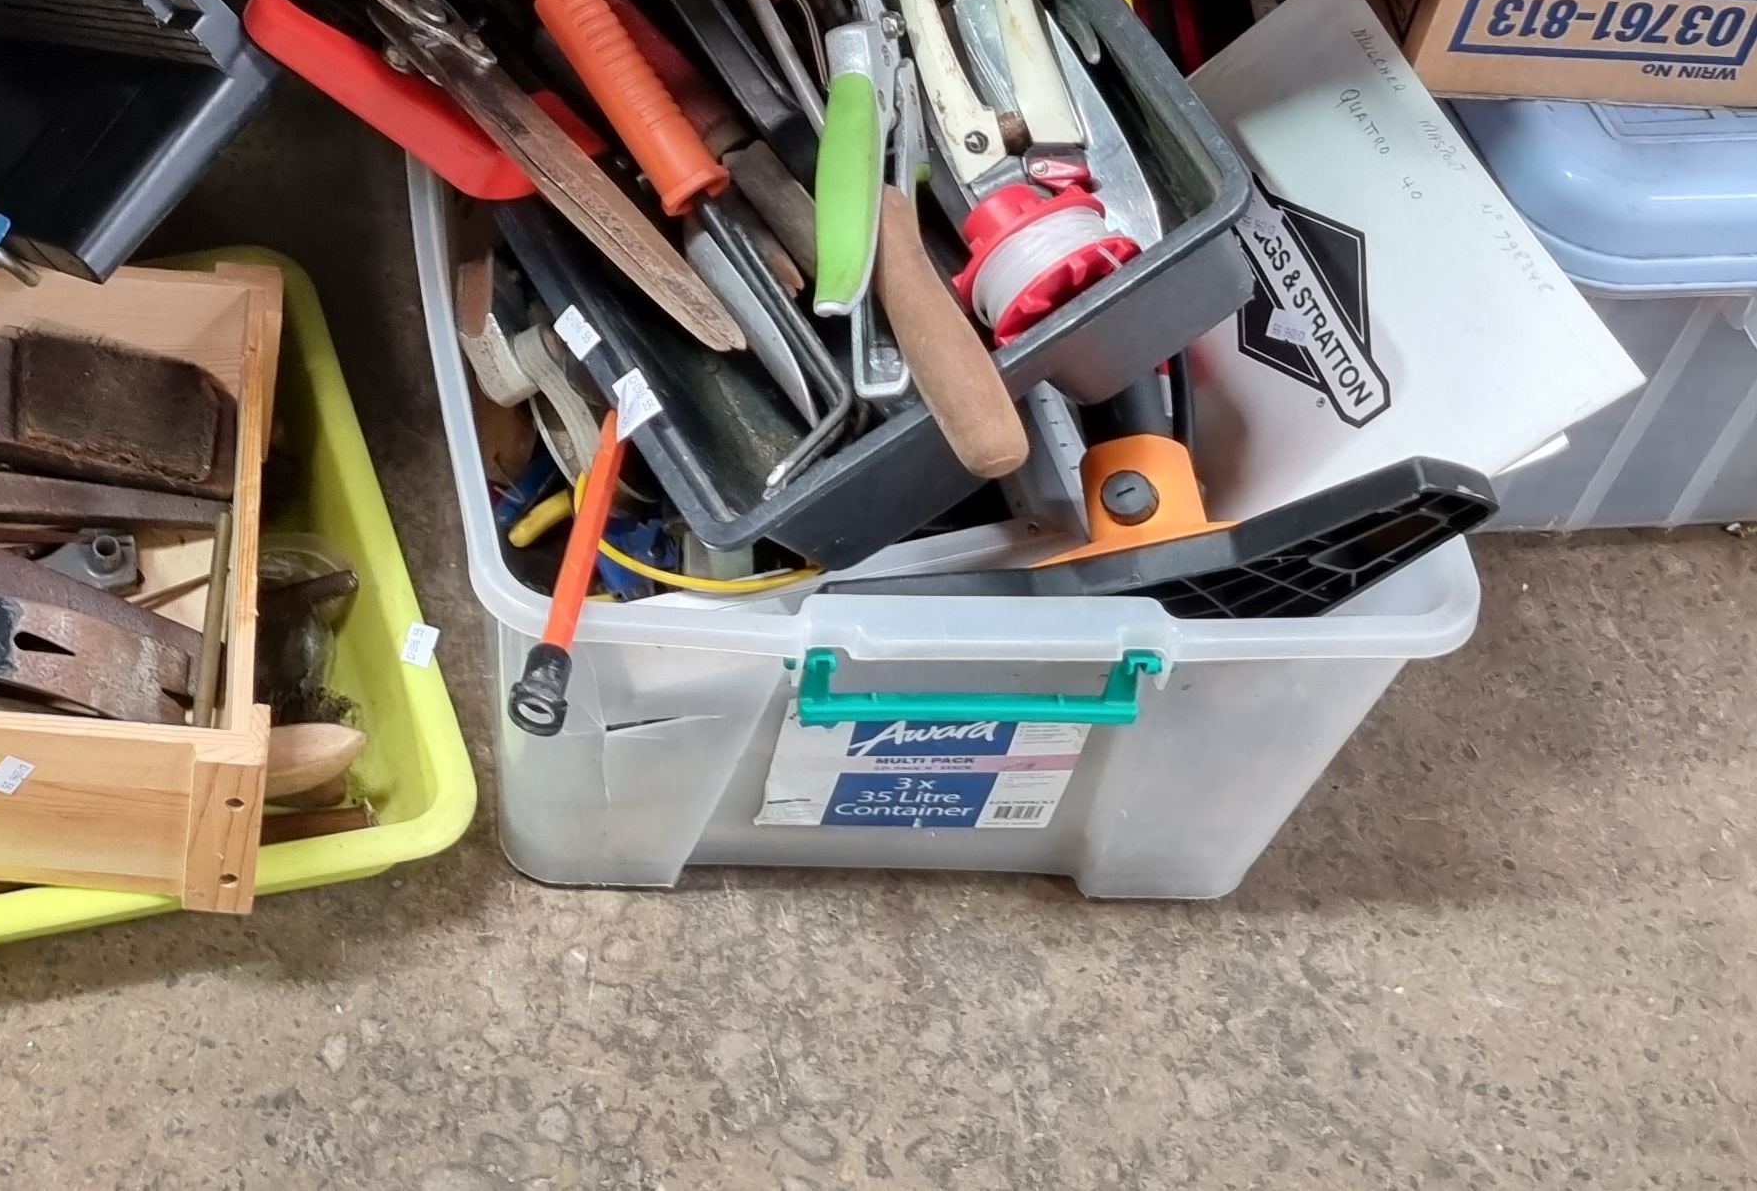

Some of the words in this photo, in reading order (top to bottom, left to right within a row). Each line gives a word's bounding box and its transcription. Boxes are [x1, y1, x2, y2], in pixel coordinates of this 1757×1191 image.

[1349, 27, 1406, 94] MULCHER
[1641, 63, 1673, 78] No
[1678, 66, 1738, 81] WRIN
[1339, 88, 1391, 156] QUATTRO
[1401, 175, 1423, 201] 40
[1282, 269, 1302, 293] &
[1292, 287, 1374, 408] STRATTON
[848, 719, 996, 757] Award
[875, 757, 926, 765] MULTI
[931, 757, 976, 765] PACK
[894, 777, 915, 790] 3
[857, 791, 893, 803] 35
[899, 790, 962, 803] Litre
[835, 803, 975, 818] Container
